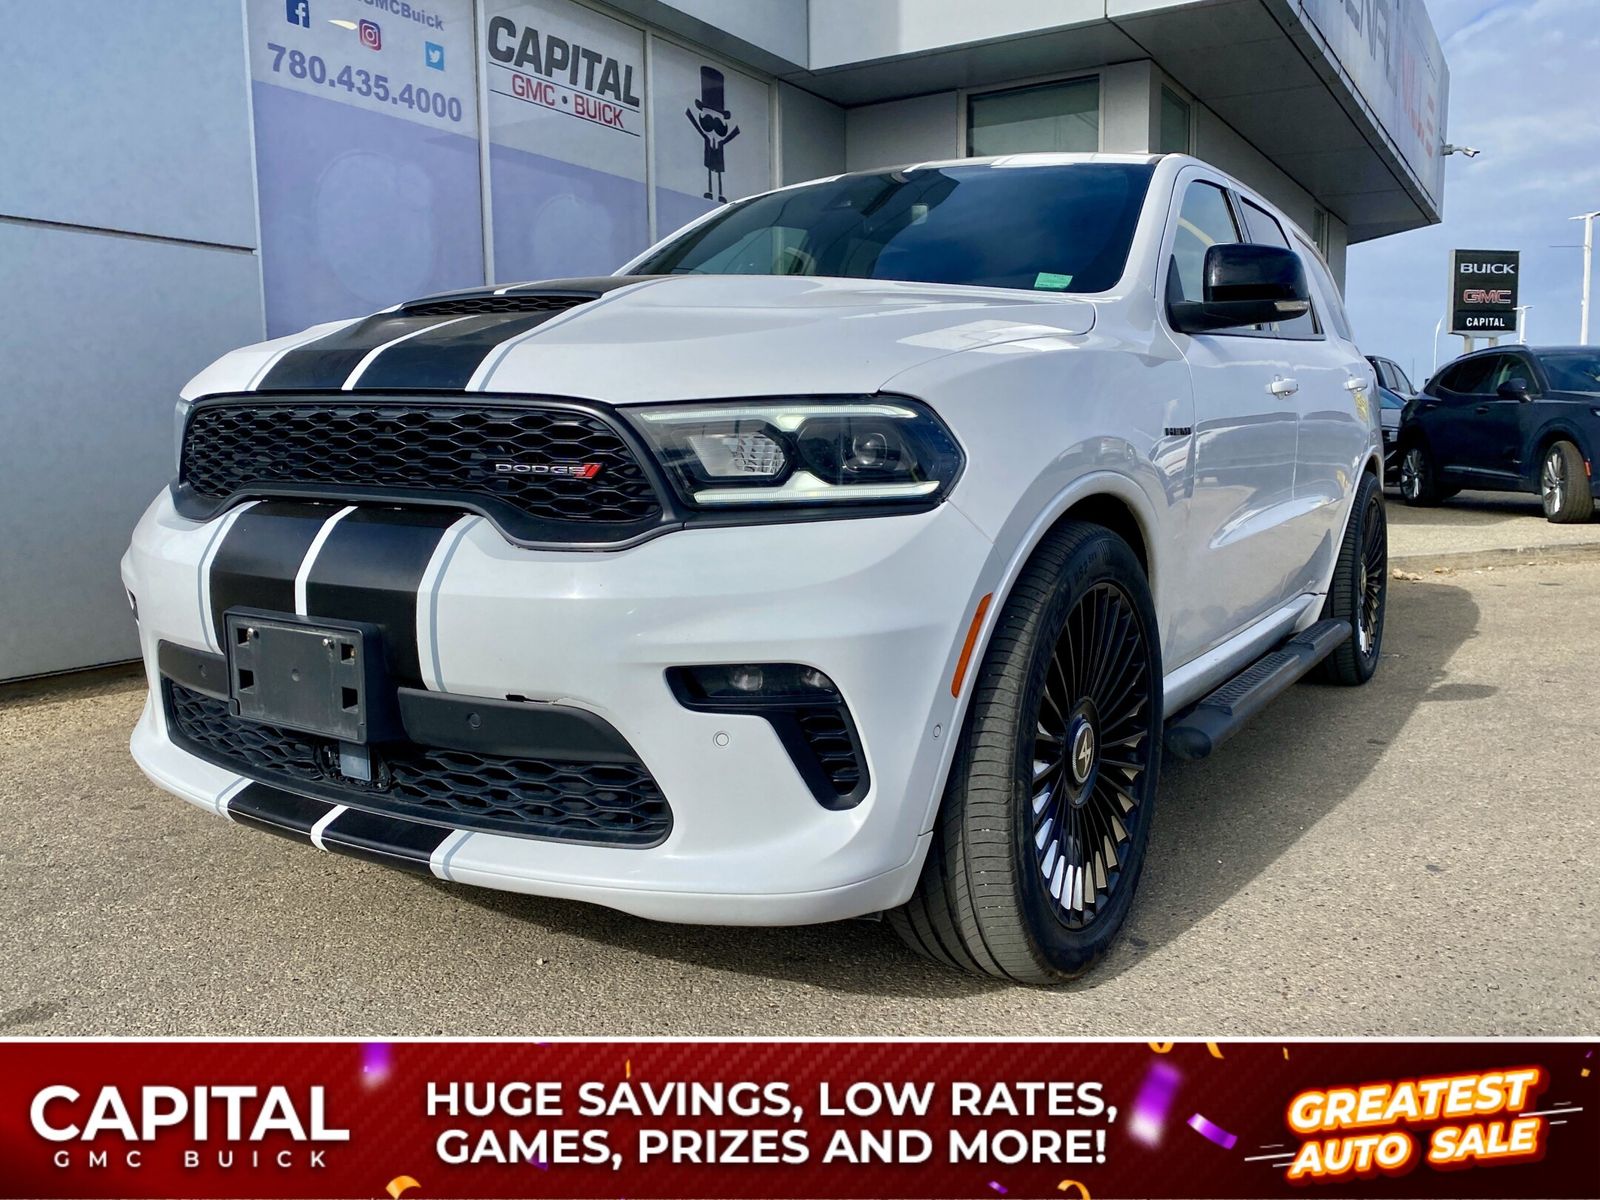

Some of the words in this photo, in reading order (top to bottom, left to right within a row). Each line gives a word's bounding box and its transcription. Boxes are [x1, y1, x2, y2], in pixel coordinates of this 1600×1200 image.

[488, 15, 640, 108] CAPITAL
[267, 42, 462, 122] 780.435.4000
[511, 73, 556, 107] GMC
[573, 93, 624, 129] BUICK
[1460, 263, 1516, 274] BUICK
[1463, 289, 1512, 304] GMC
[1466, 317, 1505, 327] CAPITAL
[495, 463, 586, 475] DODGE
